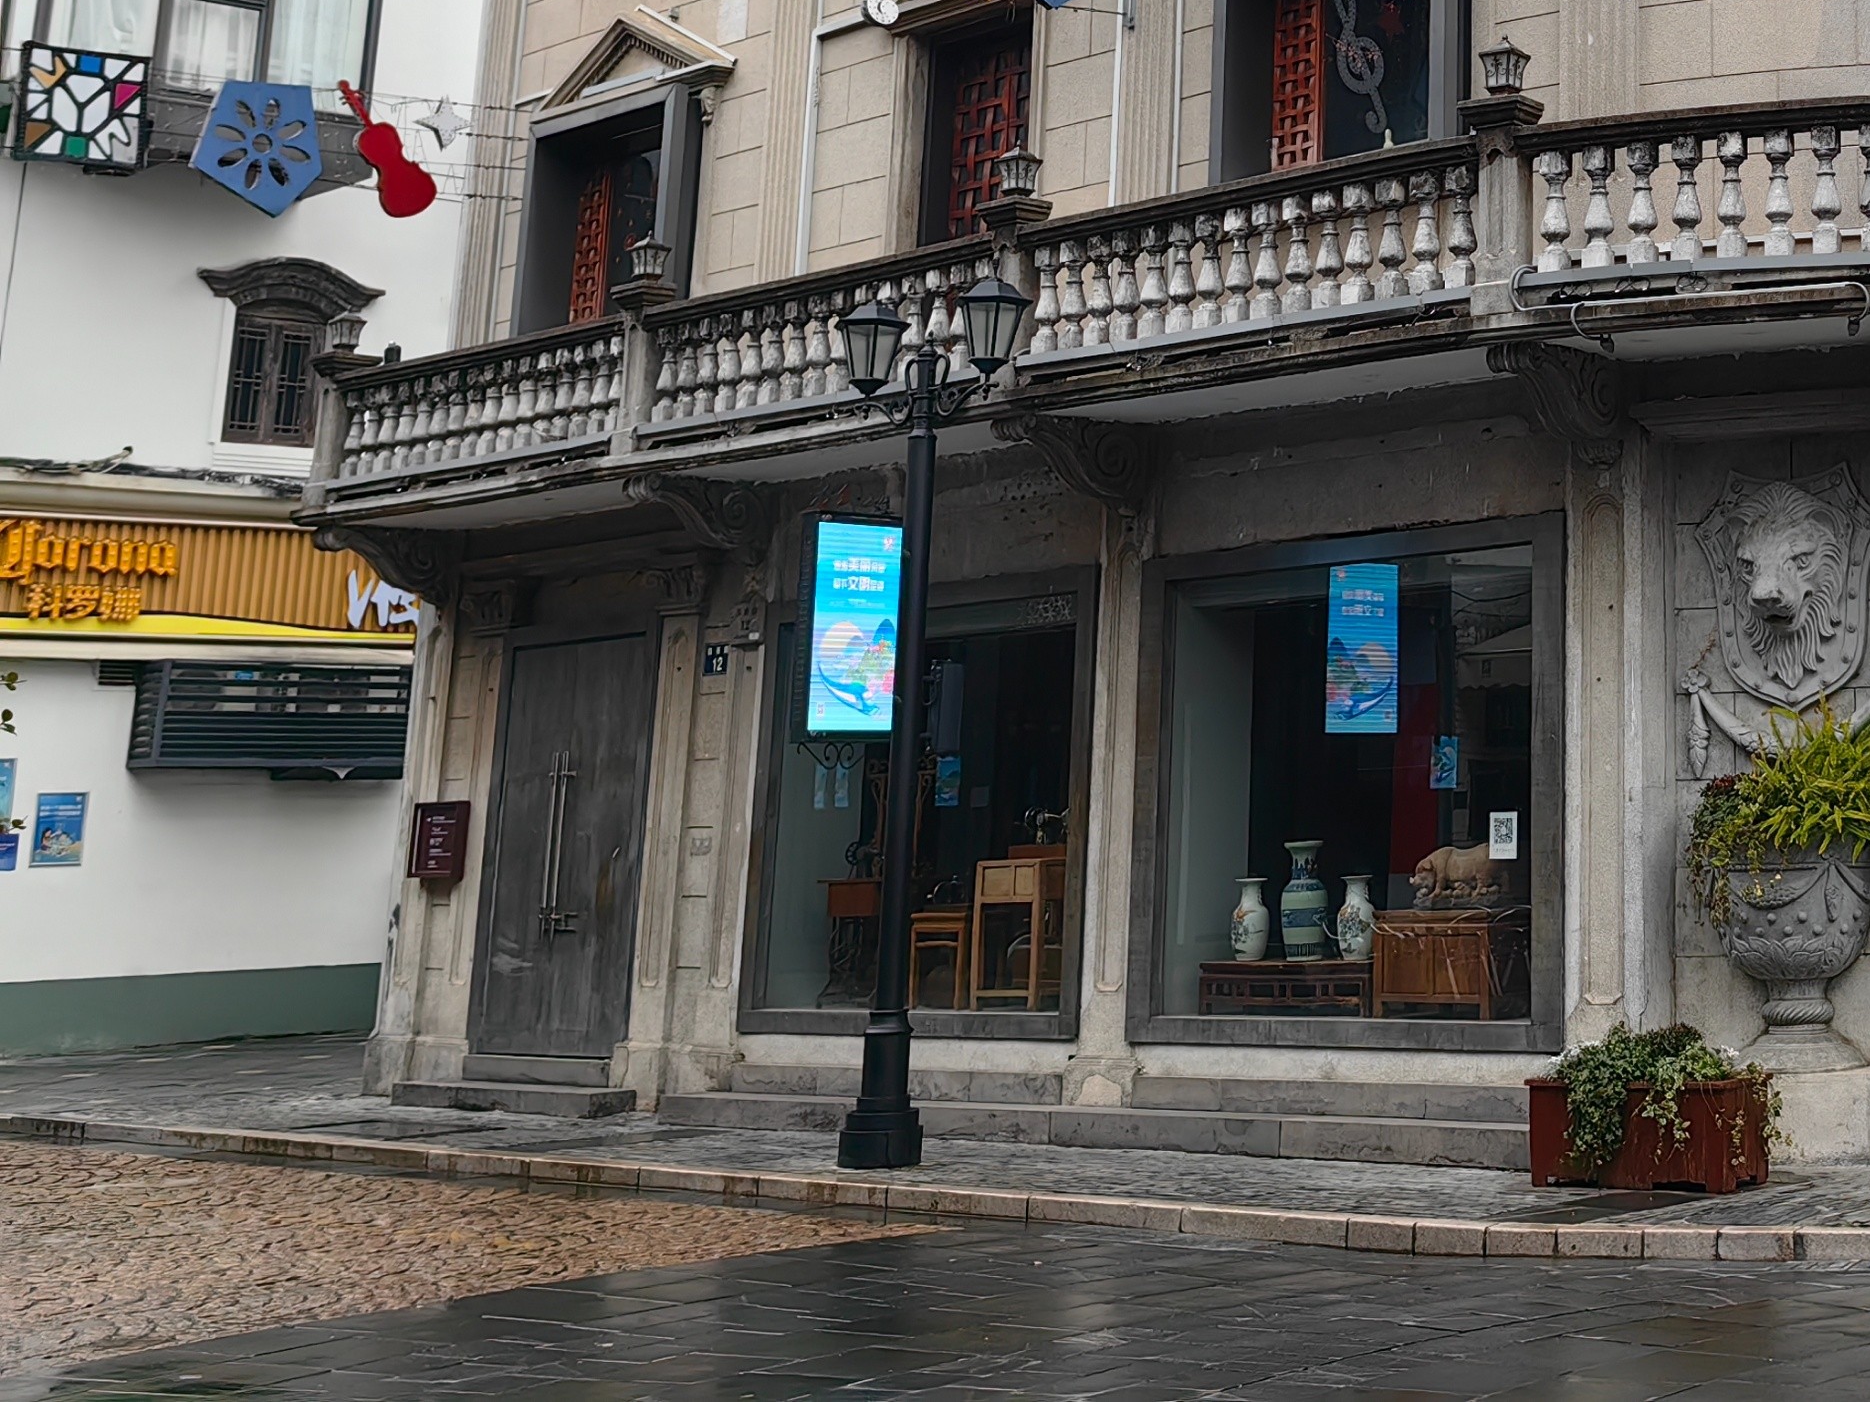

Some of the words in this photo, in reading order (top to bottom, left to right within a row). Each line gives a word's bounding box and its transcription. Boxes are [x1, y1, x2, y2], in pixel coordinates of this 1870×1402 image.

[26, 582, 142, 622] 科罗娜
[712, 656, 724, 672] 12
